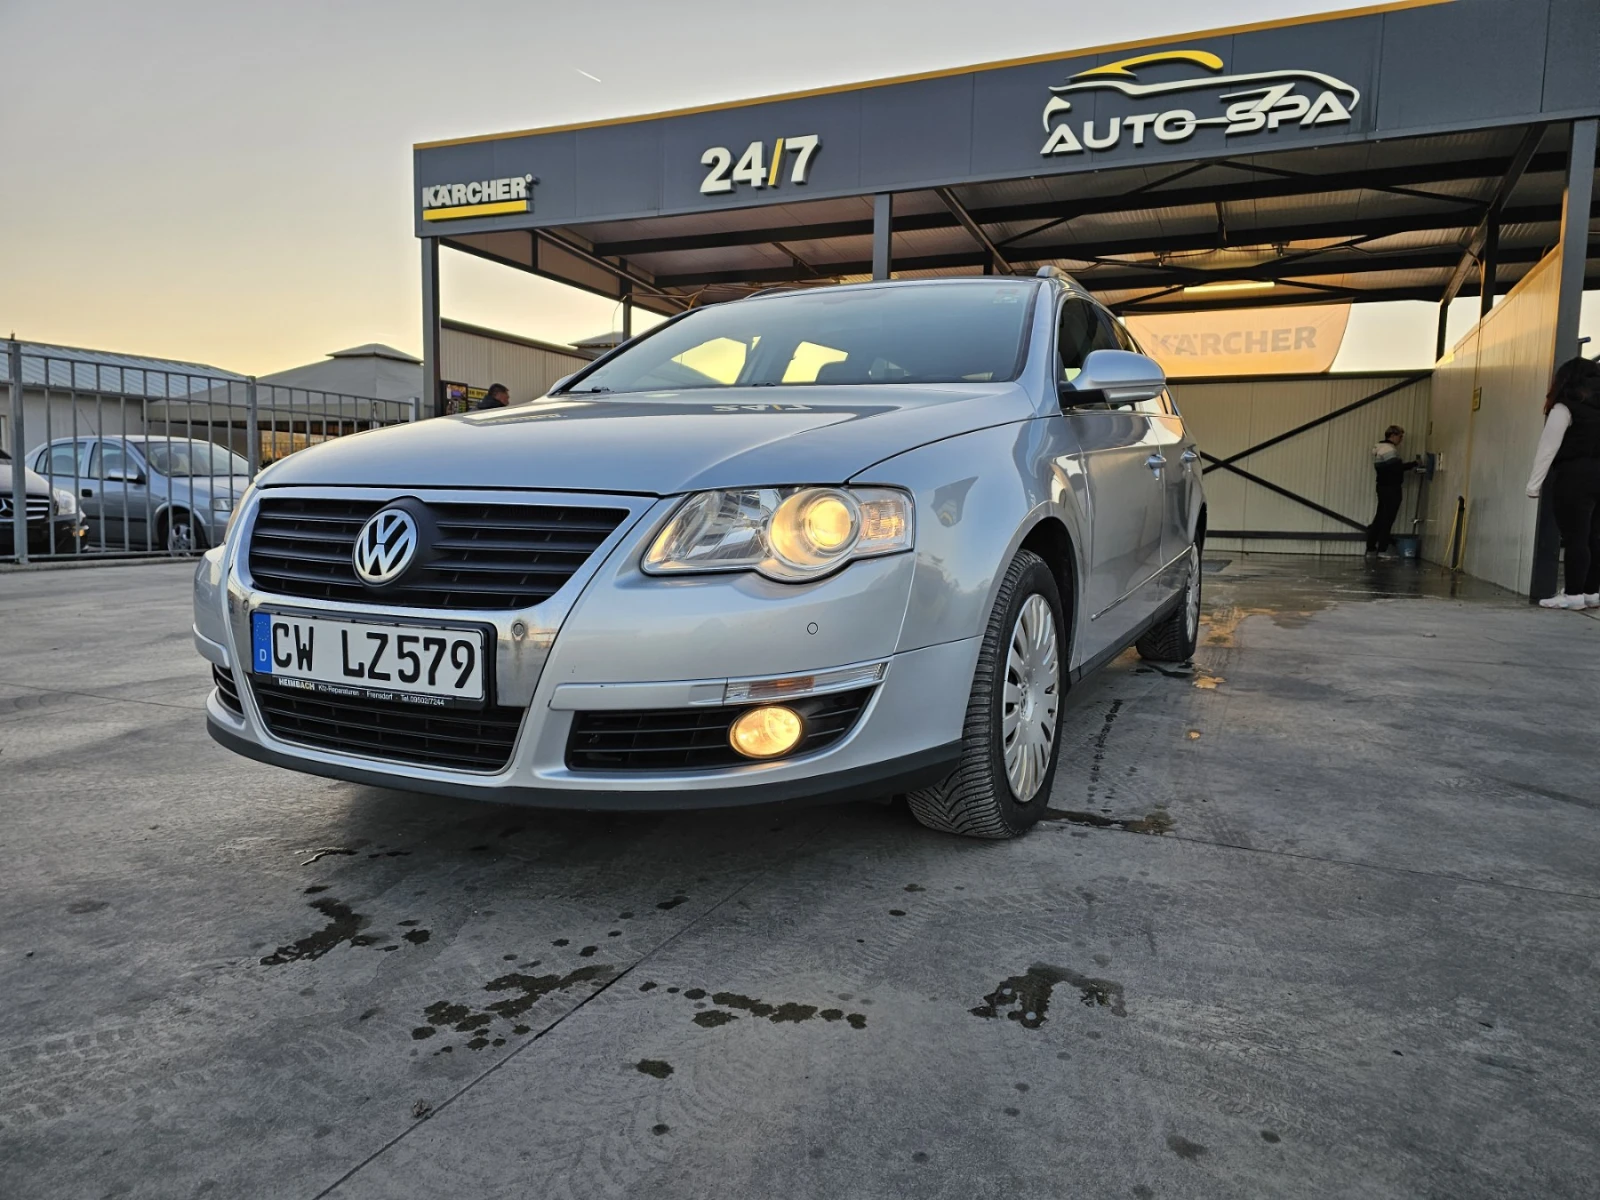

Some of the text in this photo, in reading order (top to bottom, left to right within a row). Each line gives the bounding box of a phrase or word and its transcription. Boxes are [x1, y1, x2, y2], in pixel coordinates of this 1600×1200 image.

[1040, 83, 1352, 155] AUTO SPA
[699, 134, 819, 193] 24/7
[422, 176, 527, 208] KÄRCHER
[1151, 326, 1316, 356] KÄRCHER
[260, 649, 267, 662] D
[272, 622, 314, 672] CW
